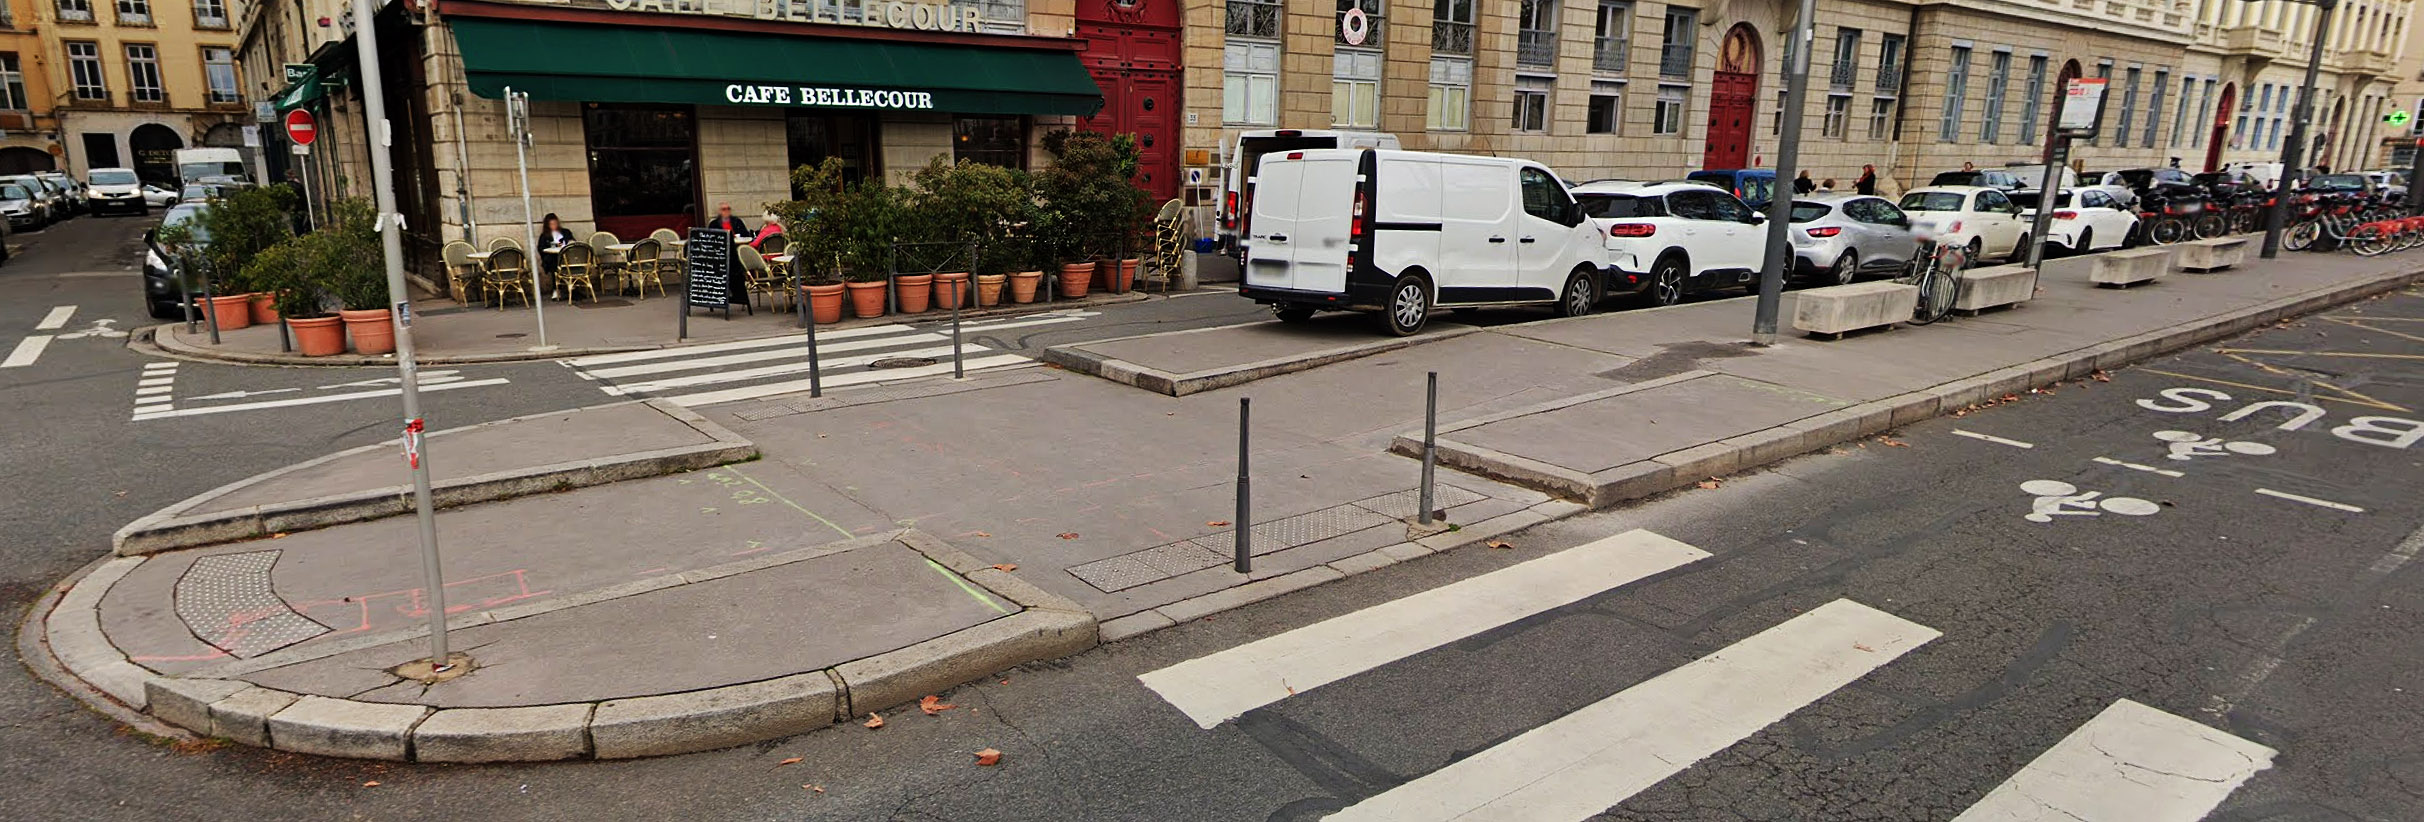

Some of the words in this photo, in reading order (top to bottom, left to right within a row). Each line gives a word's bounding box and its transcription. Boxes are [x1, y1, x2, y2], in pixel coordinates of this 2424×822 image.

[755, 0, 983, 33] BELLECOUR
[726, 84, 791, 104] CAFE
[799, 87, 934, 109] BELLECOUR
[2136, 387, 2424, 449] BUS
